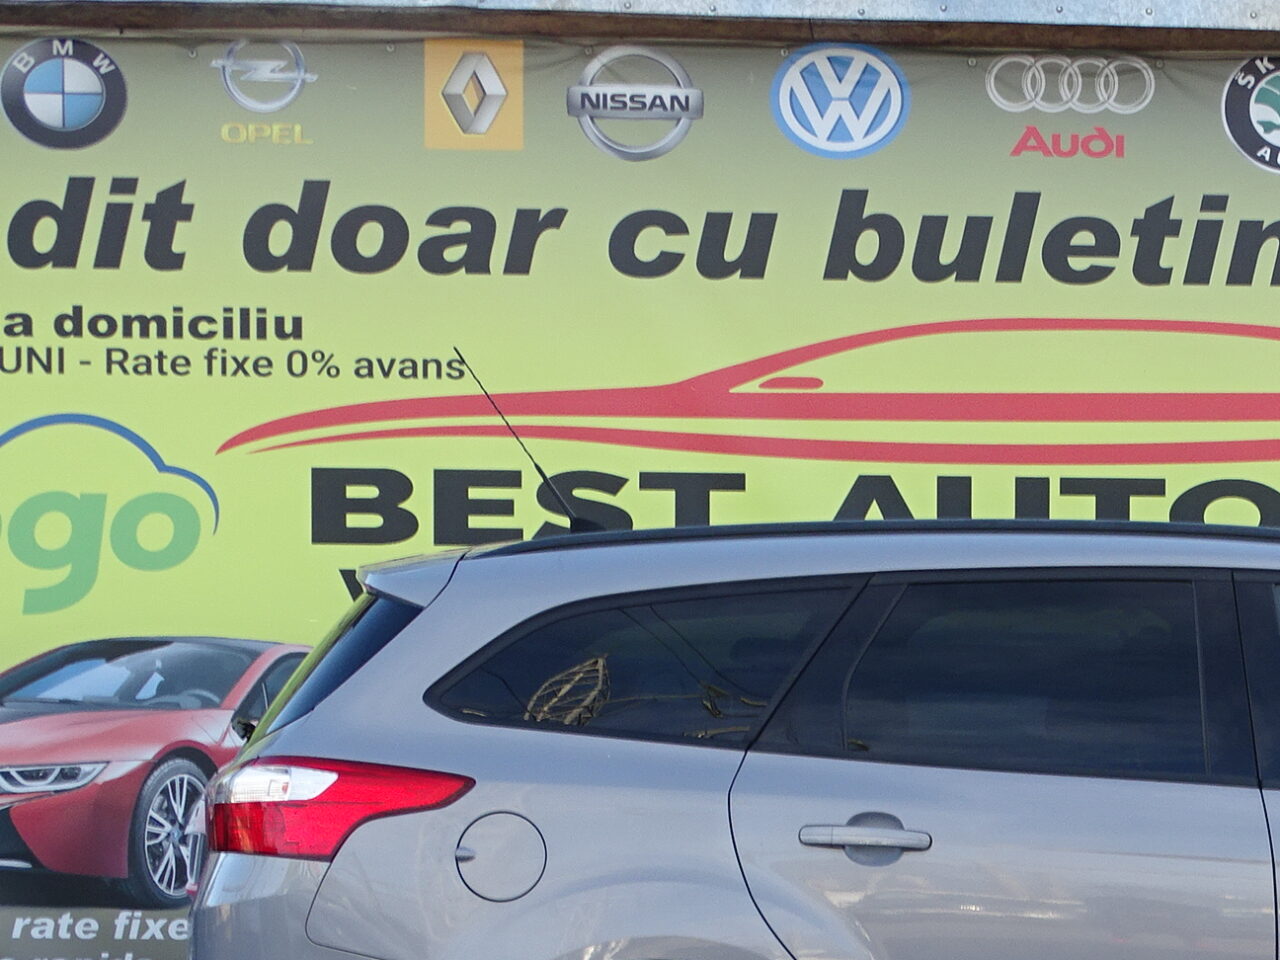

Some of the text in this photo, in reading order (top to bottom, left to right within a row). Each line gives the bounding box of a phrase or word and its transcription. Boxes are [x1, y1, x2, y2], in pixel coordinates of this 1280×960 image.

[12, 39, 116, 75] BMW
[579, 91, 690, 113] NISSAN
[220, 122, 314, 145] OPEL
[1009, 126, 1126, 159] Audi
[7, 177, 194, 271] dit
[242, 179, 567, 276] doar
[608, 209, 778, 280] cu
[3, 305, 304, 340] a domiciliu
[105, 348, 192, 376] Rate
[204, 348, 274, 378] fixe
[286, 350, 341, 379] 0%
[354, 355, 466, 380] avans
[311, 467, 746, 545] BEST
[0, 490, 202, 616] go
[12, 910, 190, 941] rate fixe
